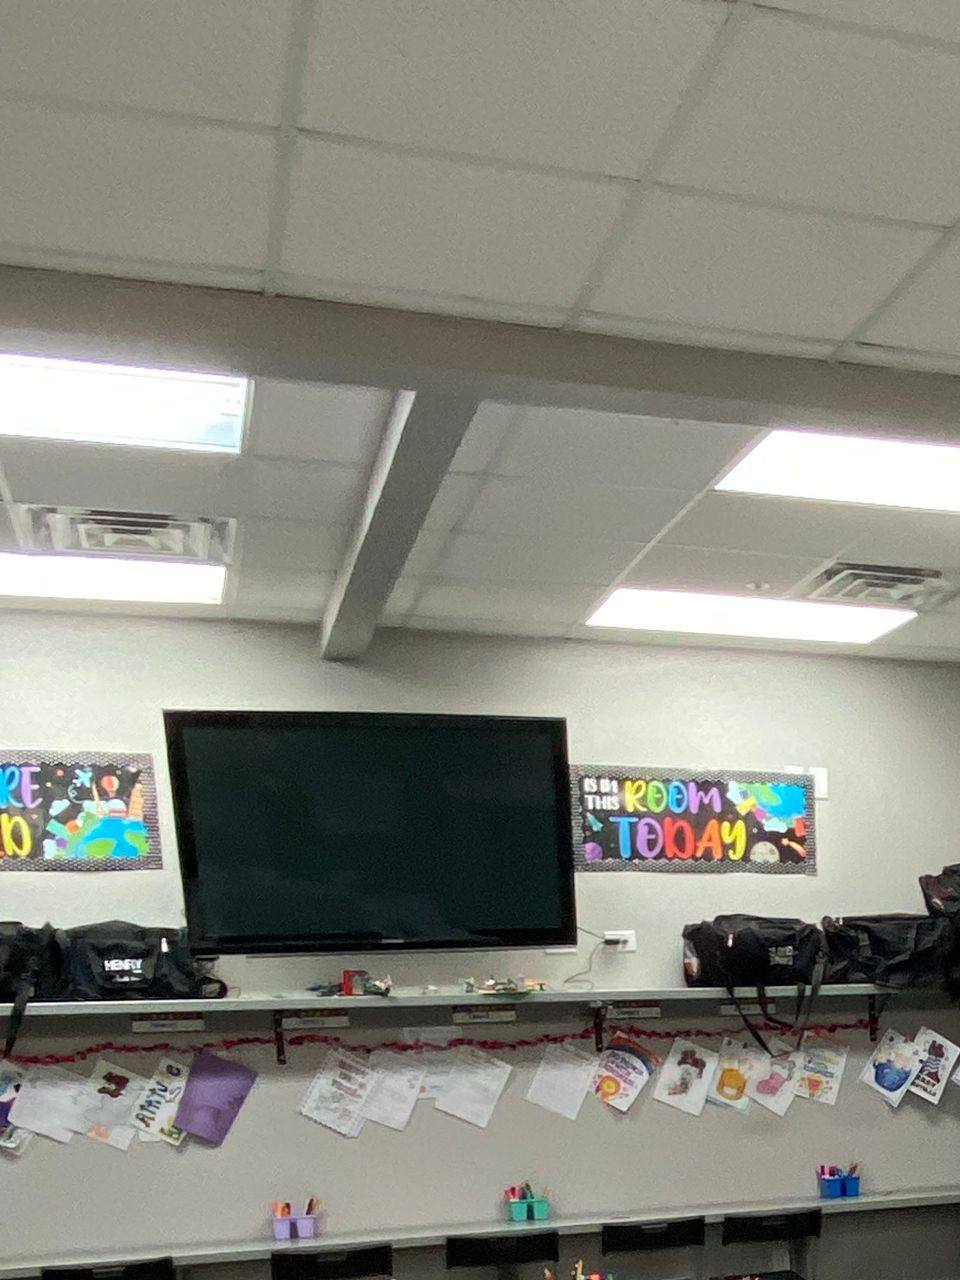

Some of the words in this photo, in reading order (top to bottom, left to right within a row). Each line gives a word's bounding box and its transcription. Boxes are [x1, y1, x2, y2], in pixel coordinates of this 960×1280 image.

[584, 778, 597, 792] IS
[624, 780, 722, 814] ROOM
[584, 795, 620, 810] THIS
[609, 816, 746, 860] TODAY
